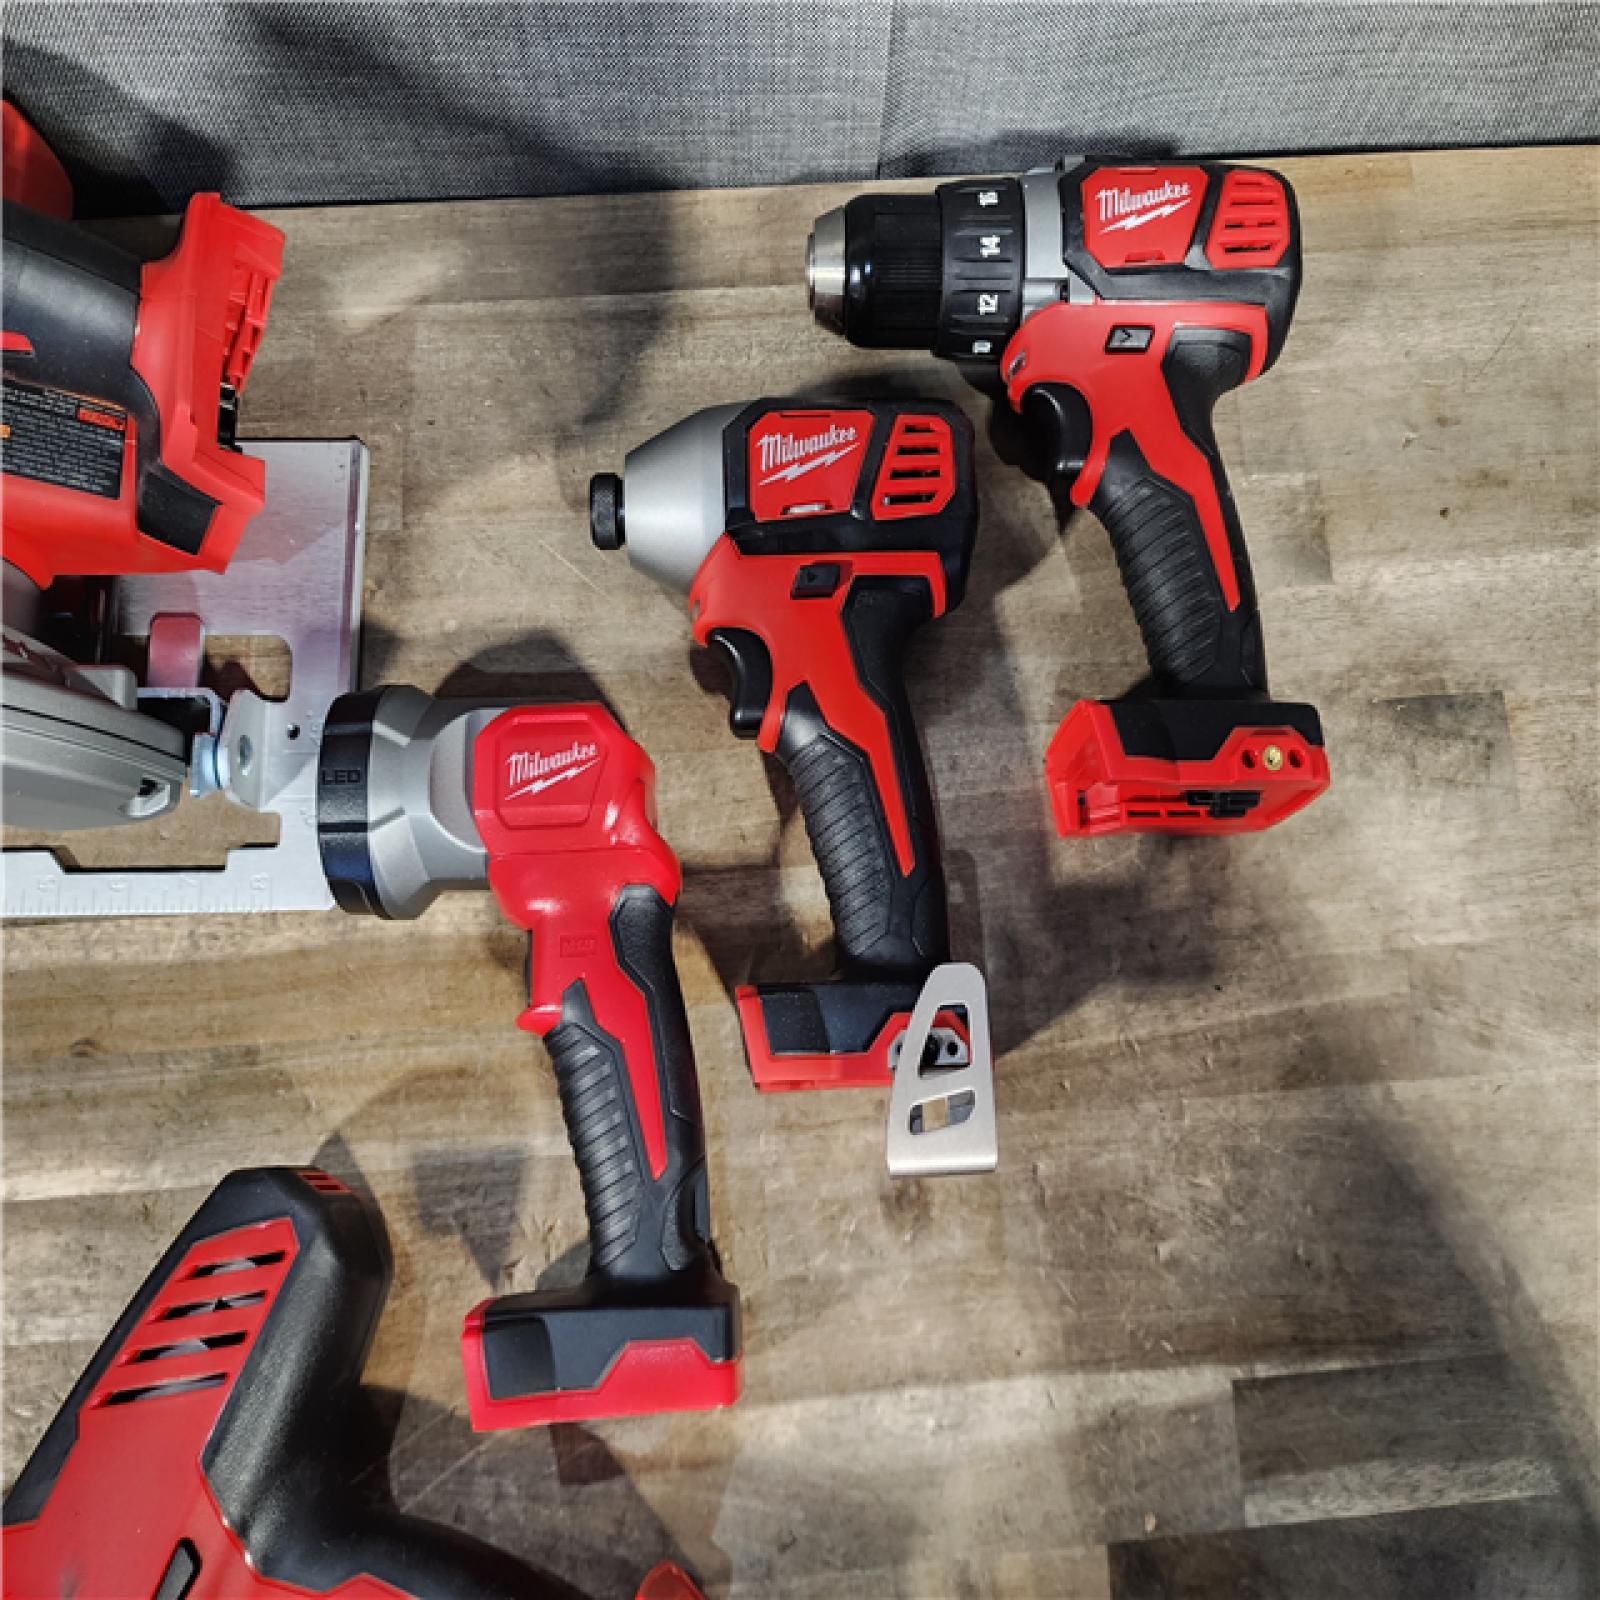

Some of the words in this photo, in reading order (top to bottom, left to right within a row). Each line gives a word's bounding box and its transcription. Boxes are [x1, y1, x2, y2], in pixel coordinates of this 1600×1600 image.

[1095, 179, 1190, 222] Milwaukee
[980, 234, 1001, 258] 14
[978, 294, 999, 316] 12
[756, 424, 857, 473] Milwaukee
[322, 769, 361, 785] LED
[505, 741, 596, 788] Milwaukee
